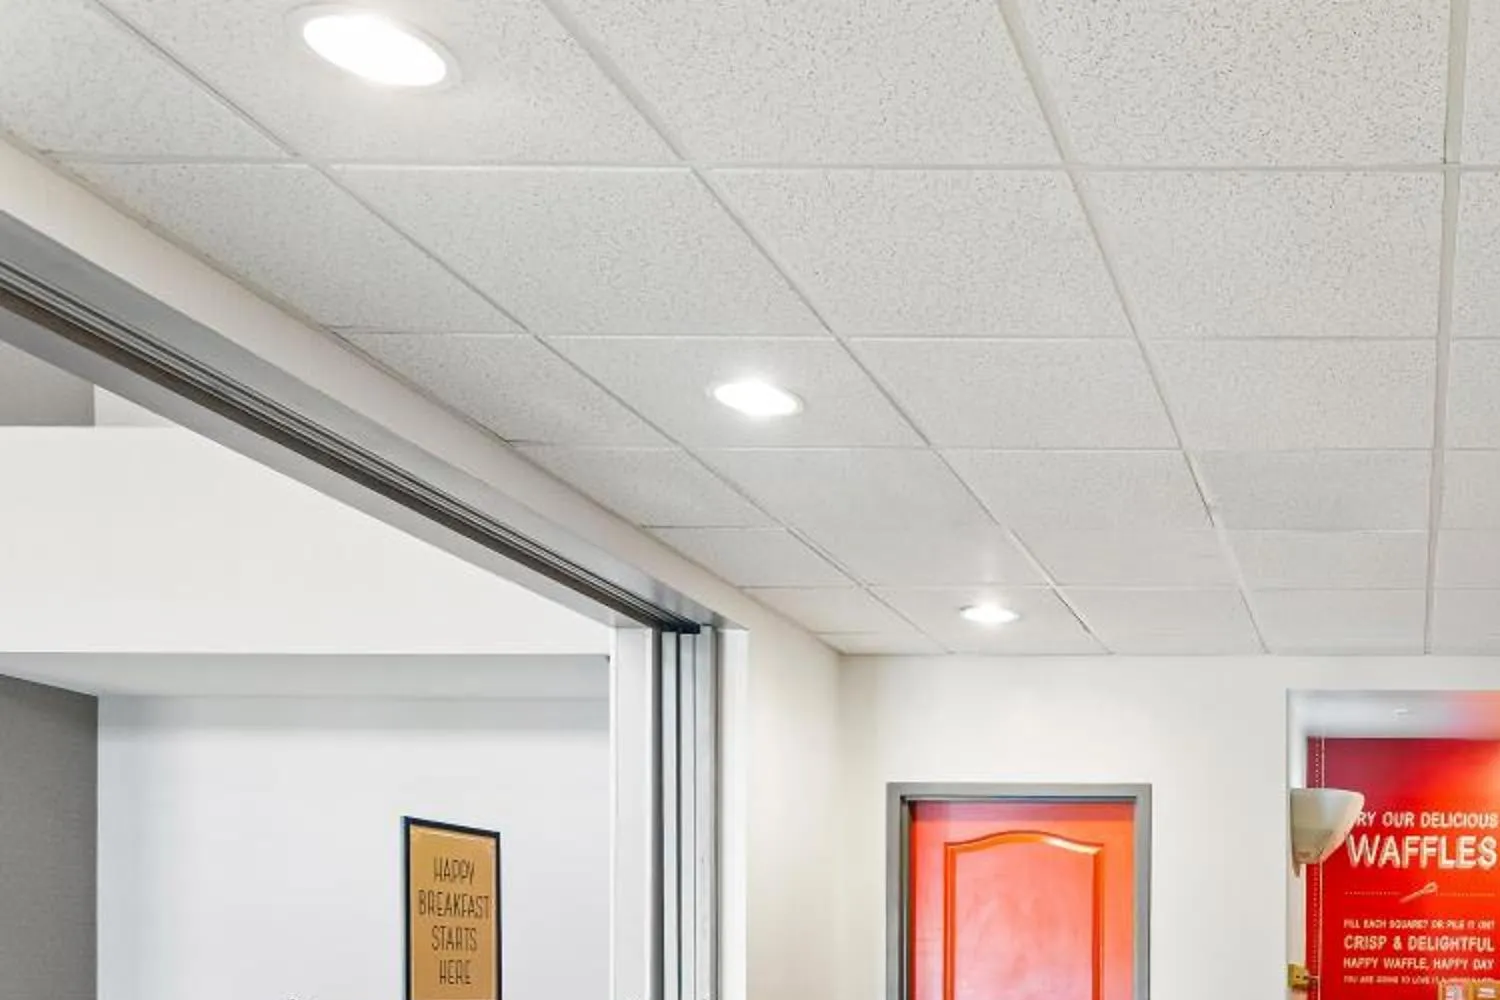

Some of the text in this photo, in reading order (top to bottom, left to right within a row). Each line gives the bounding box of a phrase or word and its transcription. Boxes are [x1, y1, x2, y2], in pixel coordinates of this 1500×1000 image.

[1352, 811, 1500, 829] RY OUR DELICIOUS
[1346, 833, 1499, 870] WAFFLES
[433, 856, 476, 885] HAPPY
[418, 889, 490, 919] BREAKFAST
[431, 925, 478, 952] STARTS
[1343, 935, 1496, 952] CRISP & DELIGHTFUL
[439, 959, 473, 985] HERE
[1343, 957, 1379, 969] HAPPY
[1433, 958, 1469, 969] HAPPY
[1473, 958, 1495, 969] DAY
